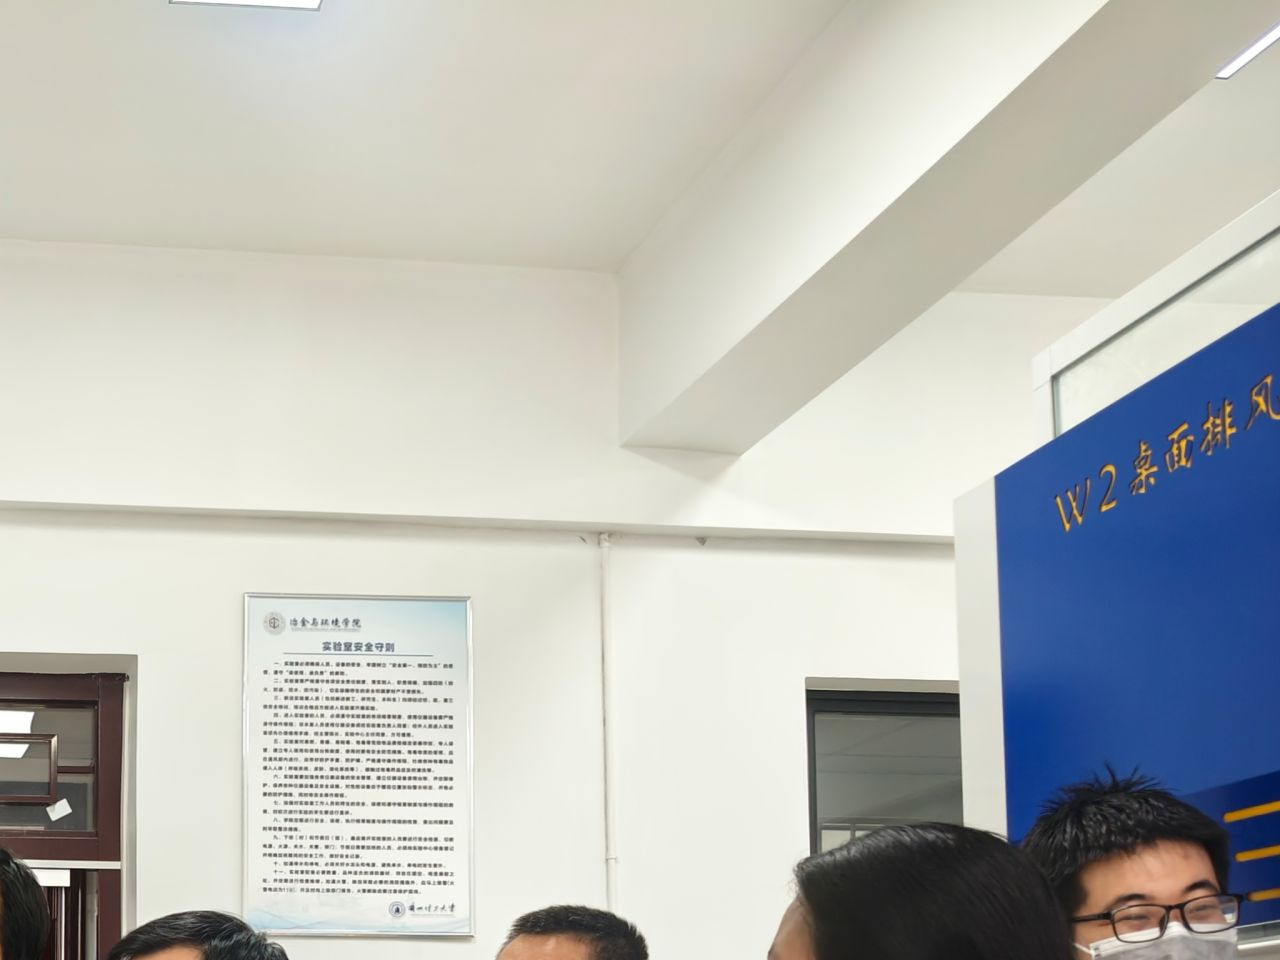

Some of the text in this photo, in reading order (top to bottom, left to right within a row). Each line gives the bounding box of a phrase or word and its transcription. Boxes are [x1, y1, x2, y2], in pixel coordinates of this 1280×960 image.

[322, 641, 395, 653] 实验室安全守则
